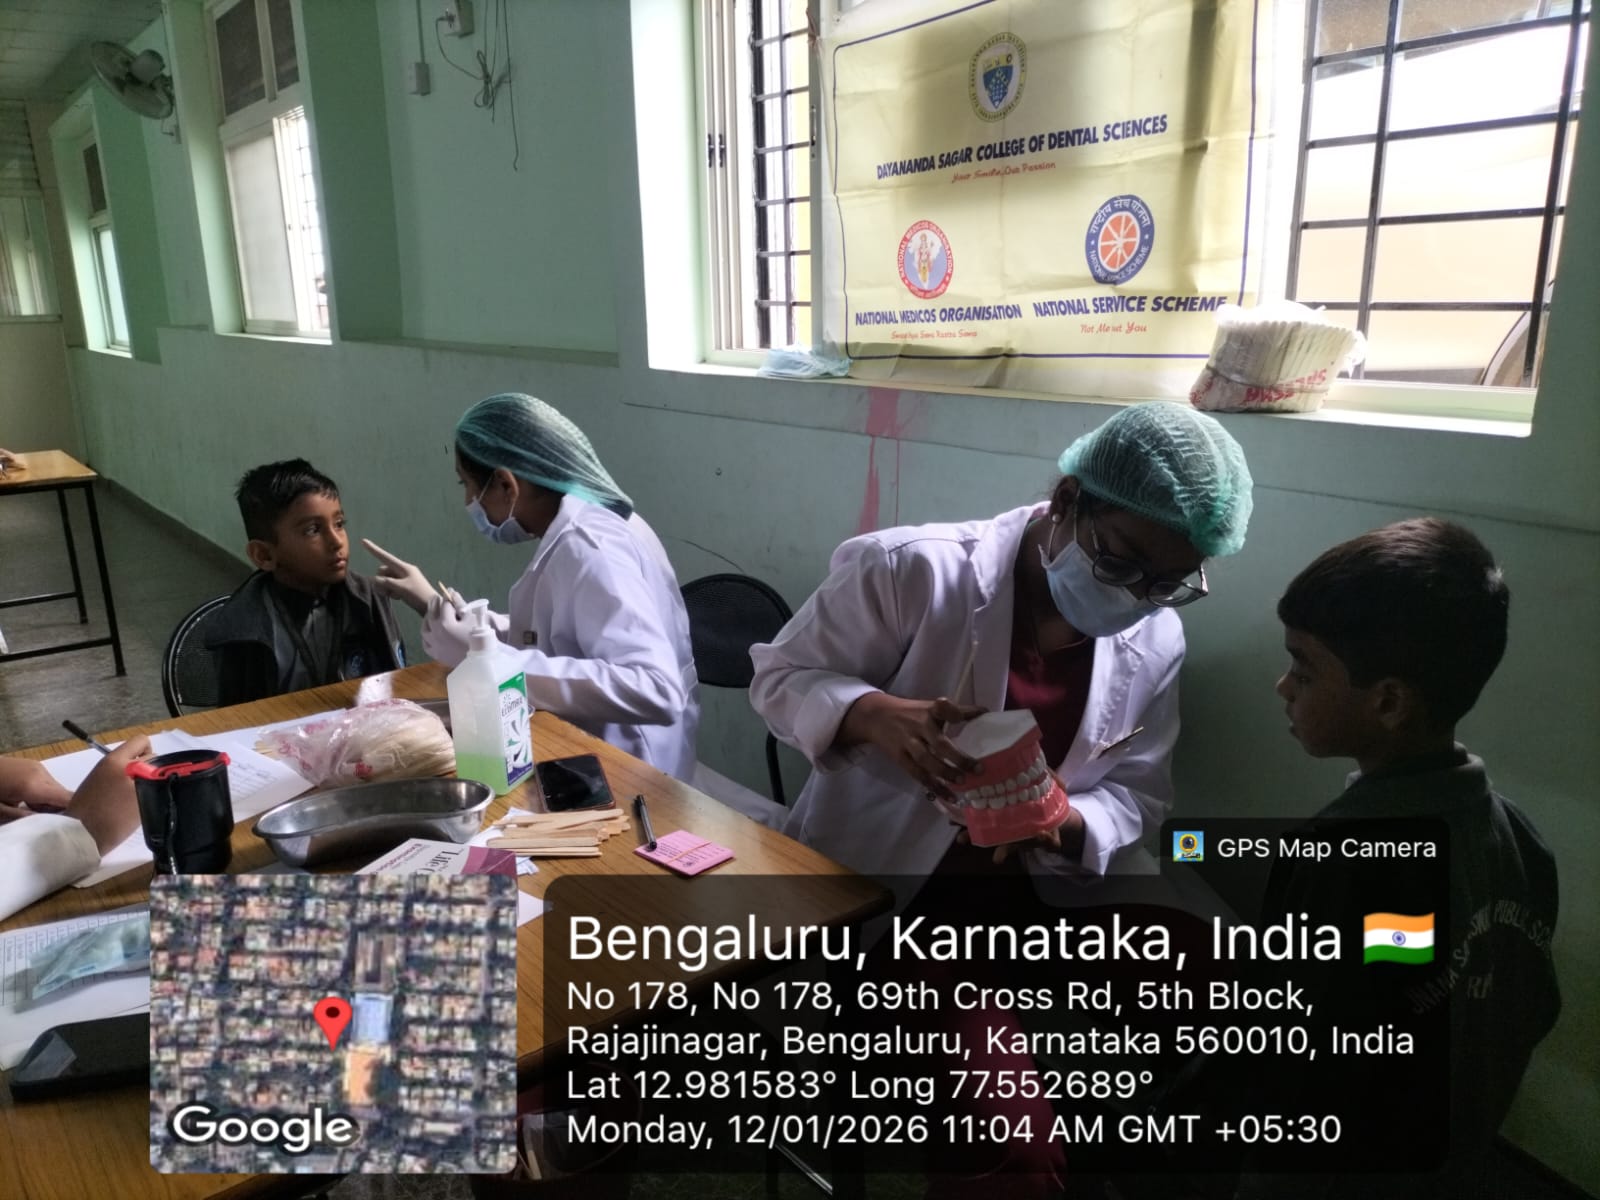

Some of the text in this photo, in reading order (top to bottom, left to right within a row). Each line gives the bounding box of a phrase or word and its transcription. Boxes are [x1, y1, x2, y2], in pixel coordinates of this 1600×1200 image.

[876, 114, 1168, 180] DAYANANDA SAGAR COLLEGE OF DENTAL SCIENCES
[855, 303, 1023, 326] NATIONAL MEDICOS ORGANISATION
[1033, 295, 1227, 317] NATIONAL SERVICE SCHEME
[1125, 321, 1147, 334] You
